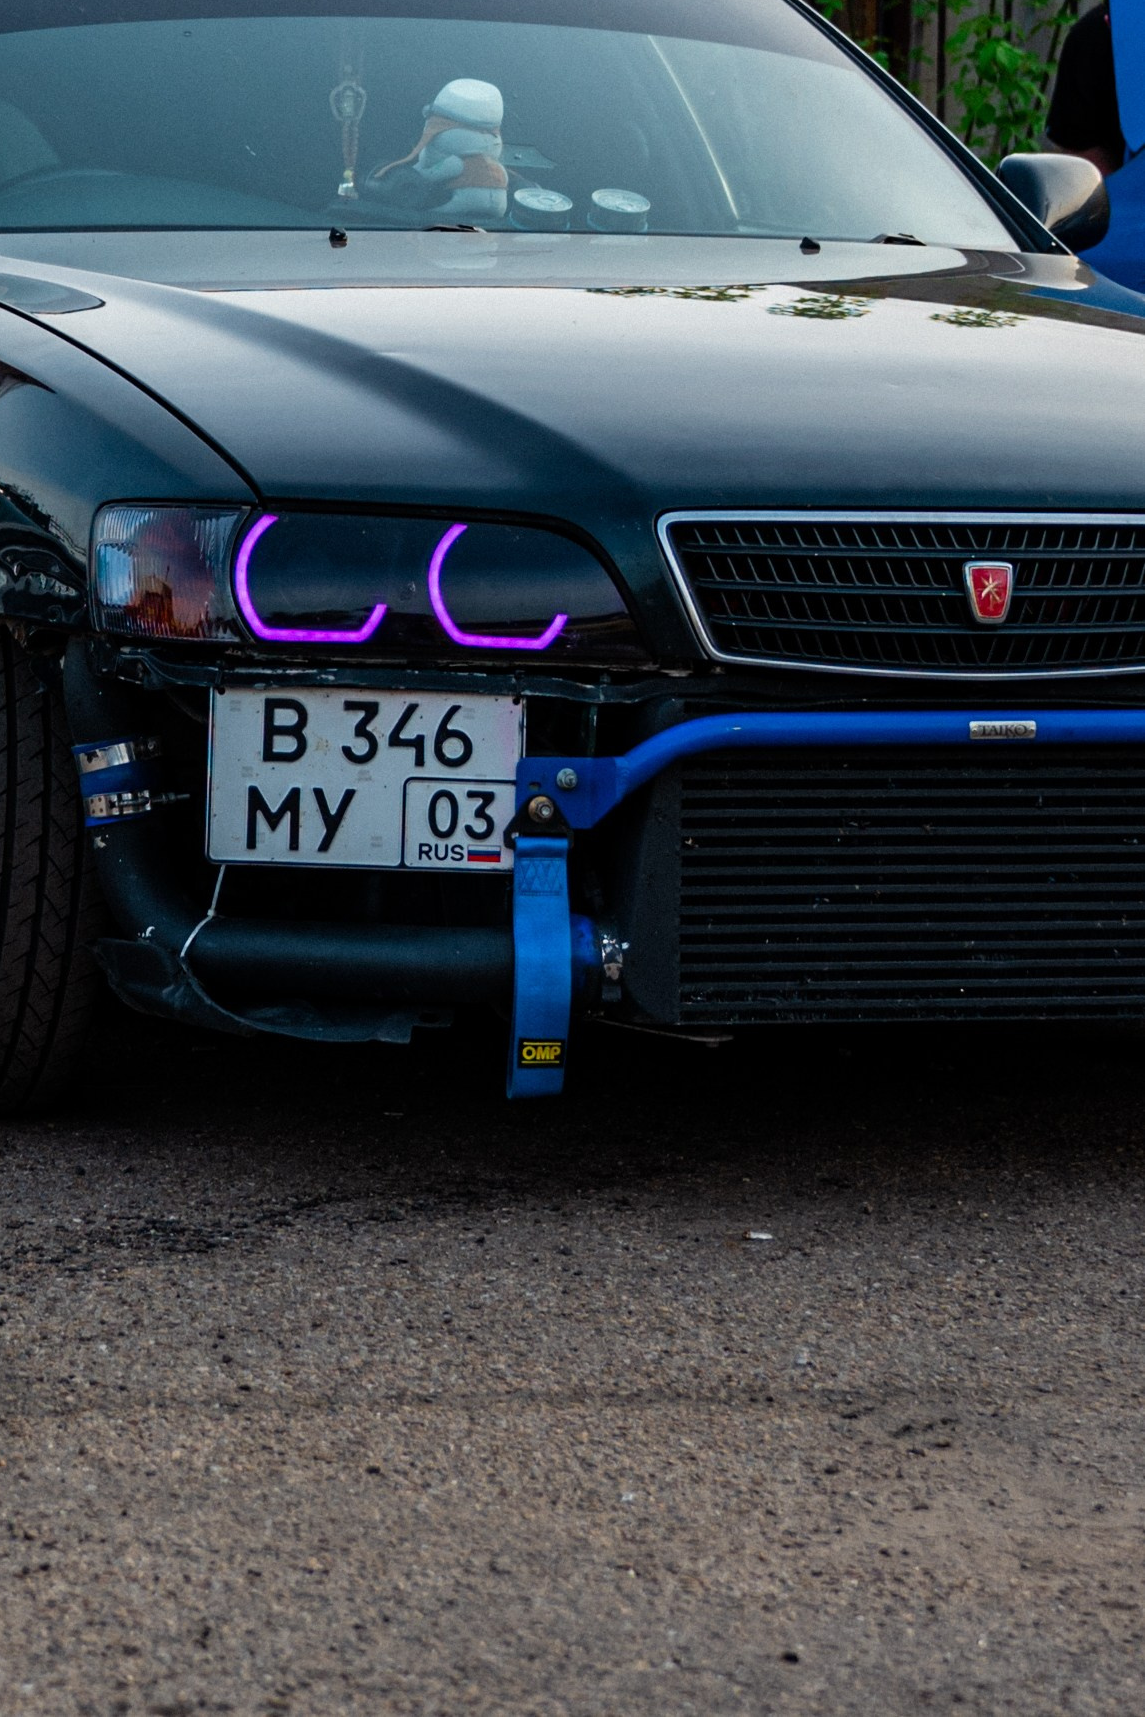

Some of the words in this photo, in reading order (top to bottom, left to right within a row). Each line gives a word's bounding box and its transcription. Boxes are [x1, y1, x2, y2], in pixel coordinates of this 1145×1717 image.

[262, 698, 308, 762] В
[341, 700, 473, 768] 346
[977, 724, 1027, 737] TAIKO
[246, 785, 356, 852] МУ
[427, 789, 496, 840] 03
[418, 843, 464, 861] RUS
[522, 1045, 561, 1060] OMP
